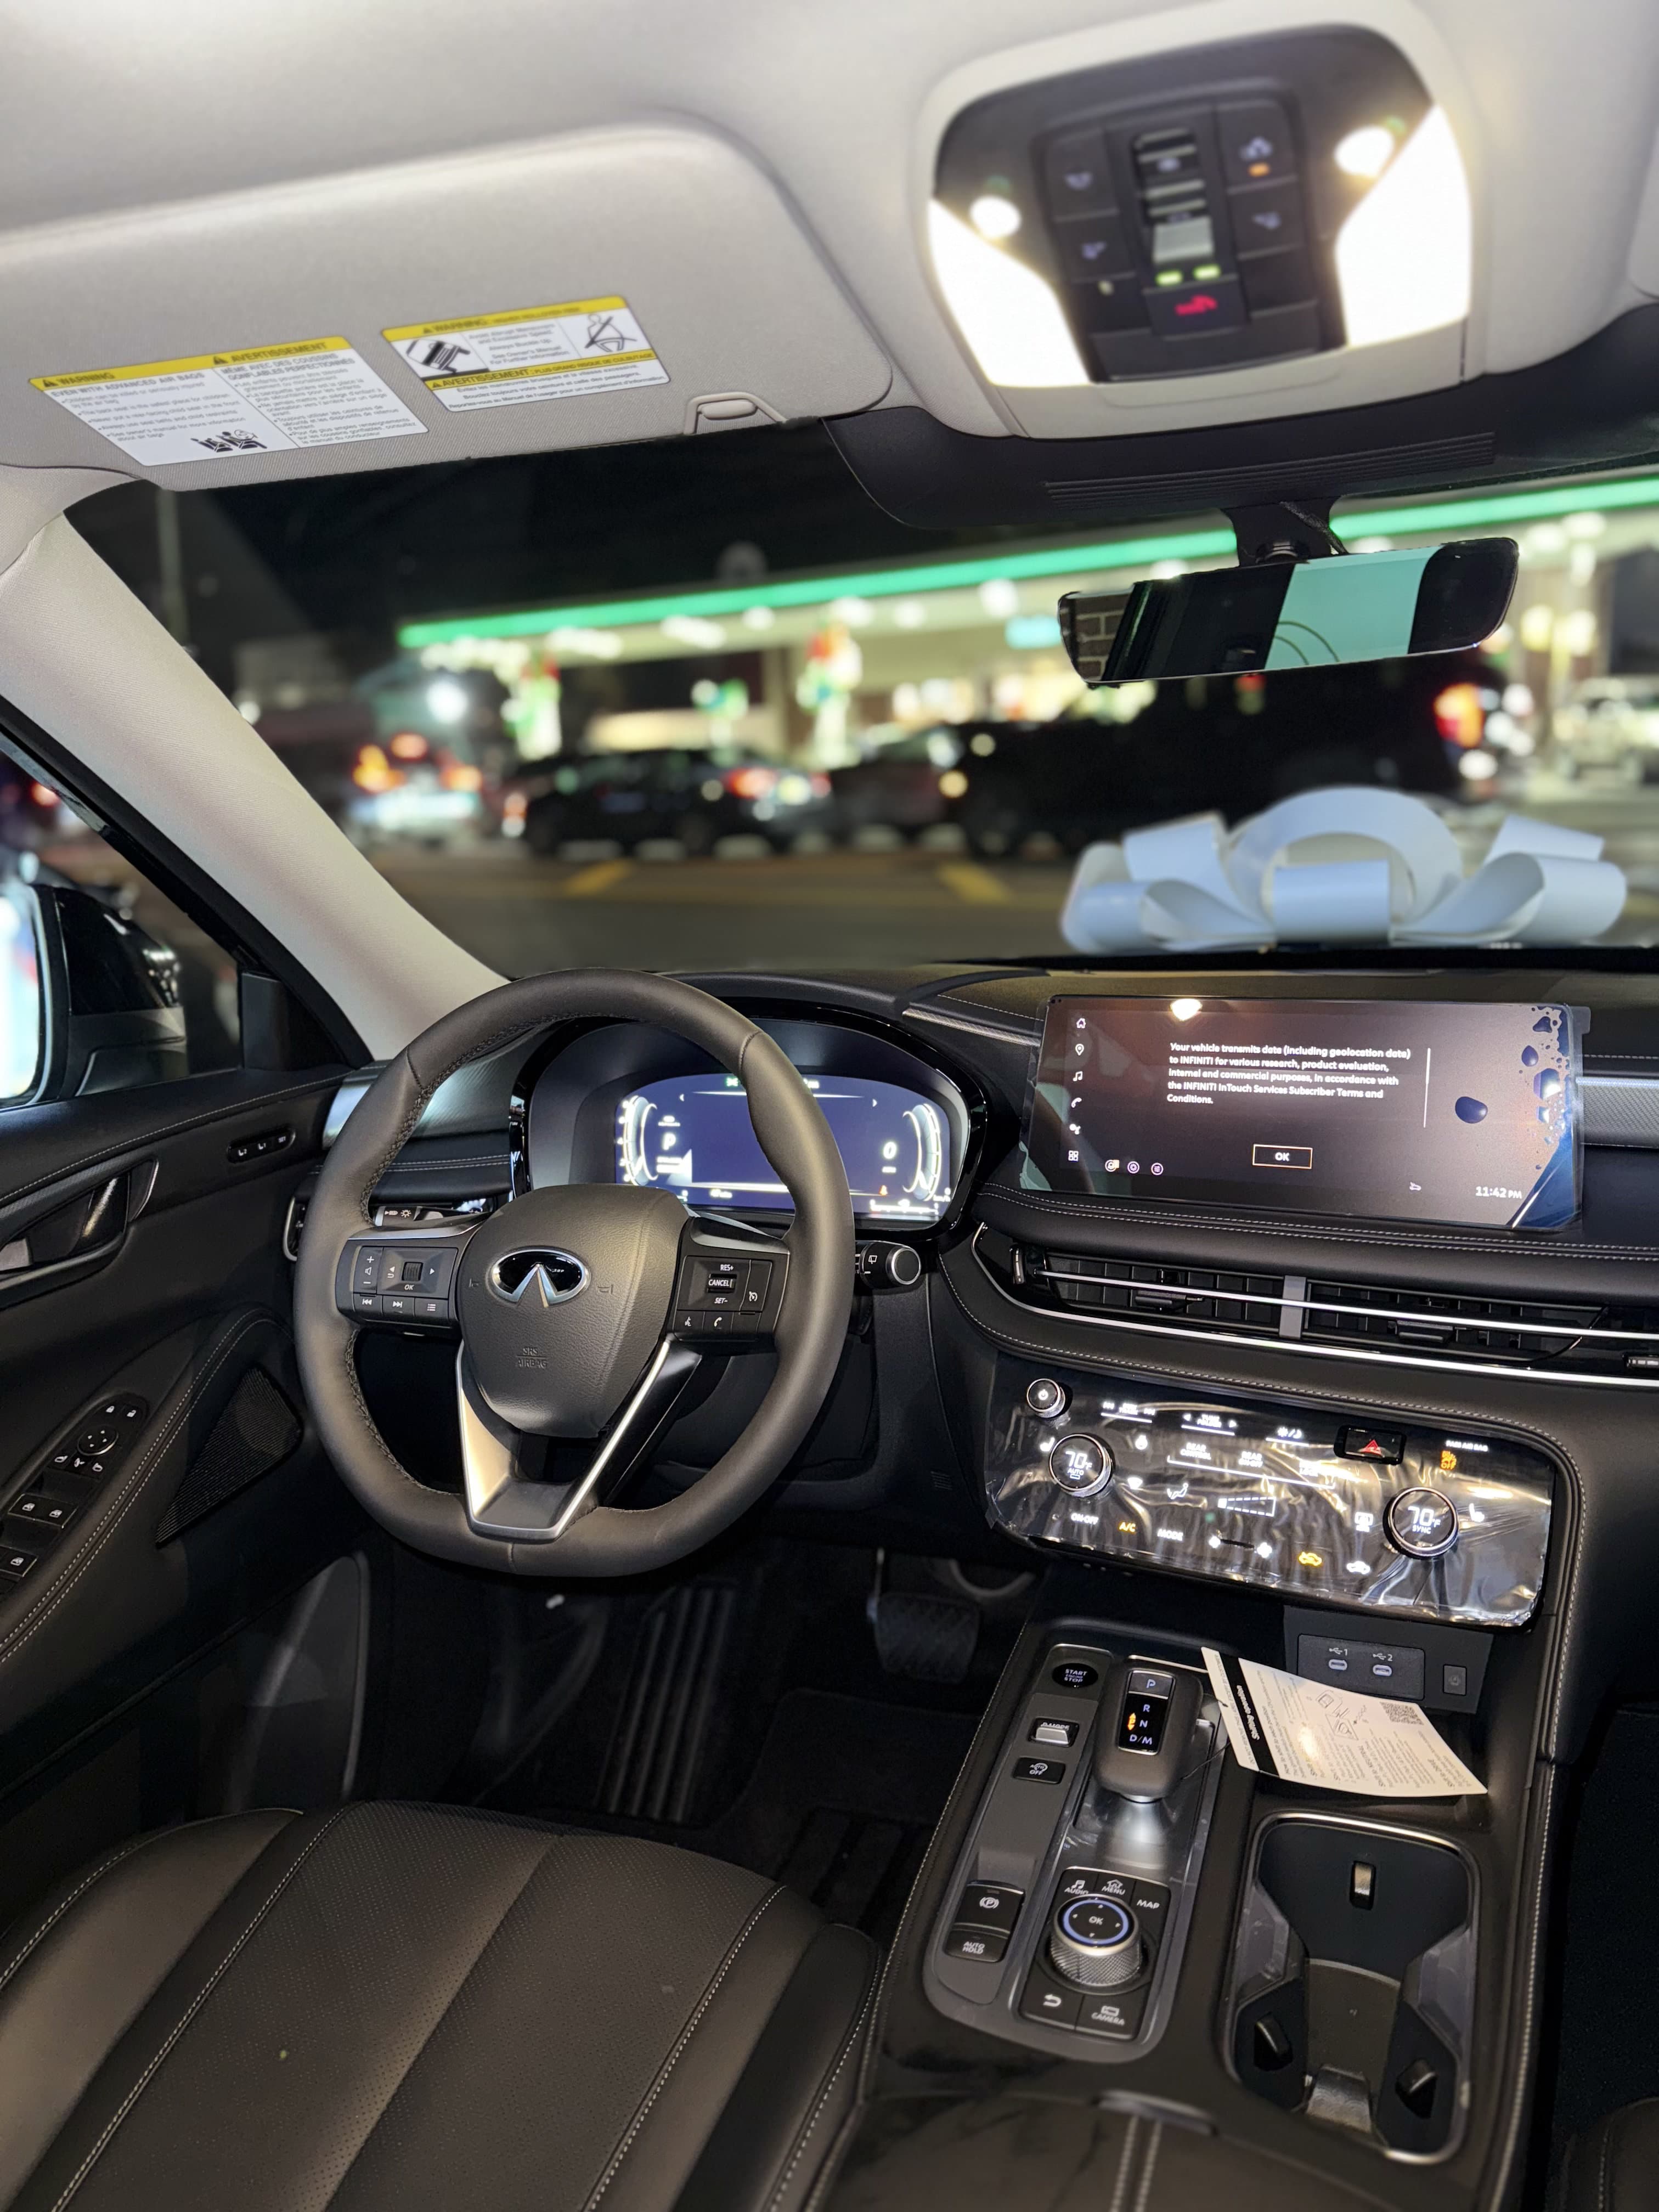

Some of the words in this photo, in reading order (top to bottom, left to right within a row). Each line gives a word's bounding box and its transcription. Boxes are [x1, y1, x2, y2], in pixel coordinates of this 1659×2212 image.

[1170, 1043, 1190, 1051] Your
[1191, 1043, 1220, 1052] vehicle
[1222, 1045, 1261, 1053] transmits
[1262, 1045, 1282, 1054] data
[1284, 1045, 1328, 1057] (including
[1330, 1048, 1384, 1058] geolocation
[1386, 1049, 1410, 1059] data)
[1180, 1056, 1214, 1065] INFINITI
[1215, 1057, 1228, 1065] for
[1229, 1058, 1260, 1066] various
[1262, 1059, 1300, 1069] research,
[1301, 1060, 1337, 1070] product
[1338, 1062, 1389, 1072] evaluation,
[1220, 1071, 1268, 1080] commercial
[1271, 1073, 1312, 1083] purposes,
[1314, 1074, 1323, 1082] in
[1325, 1075, 1376, 1084] accordance
[1378, 1076, 1398, 1085] with
[1183, 1082, 1216, 1091] INFINITI
[1218, 1084, 1251, 1092] InTouch
[1254, 1085, 1287, 1094] Services
[1289, 1086, 1335, 1096] Subscriber
[1336, 1088, 1364, 1097] Terms
[1365, 1090, 1383, 1098] and
[1167, 1094, 1214, 1104] Conditions.
[662, 1132, 676, 1150] P
[883, 1142, 896, 1159] 0
[1275, 1152, 1289, 1161] OK
[1476, 1186, 1506, 1198] 11:42
[1508, 1190, 1522, 1199] PM
[523, 1347, 538, 1356] SRS
[1119, 1522, 1136, 1532] A/C
[1413, 1526, 1431, 1534] SYNC
[1157, 1529, 1183, 1541] MODE
[1146, 1679, 1156, 1689] P
[1143, 1704, 1150, 1712] R
[1129, 1734, 1153, 1745] D/M
[1102, 1886, 1125, 1895] MENU
[1136, 1899, 1160, 1909] MAP
[1088, 1916, 1104, 1925] OK
[1091, 2012, 1125, 2025] CAMERA
